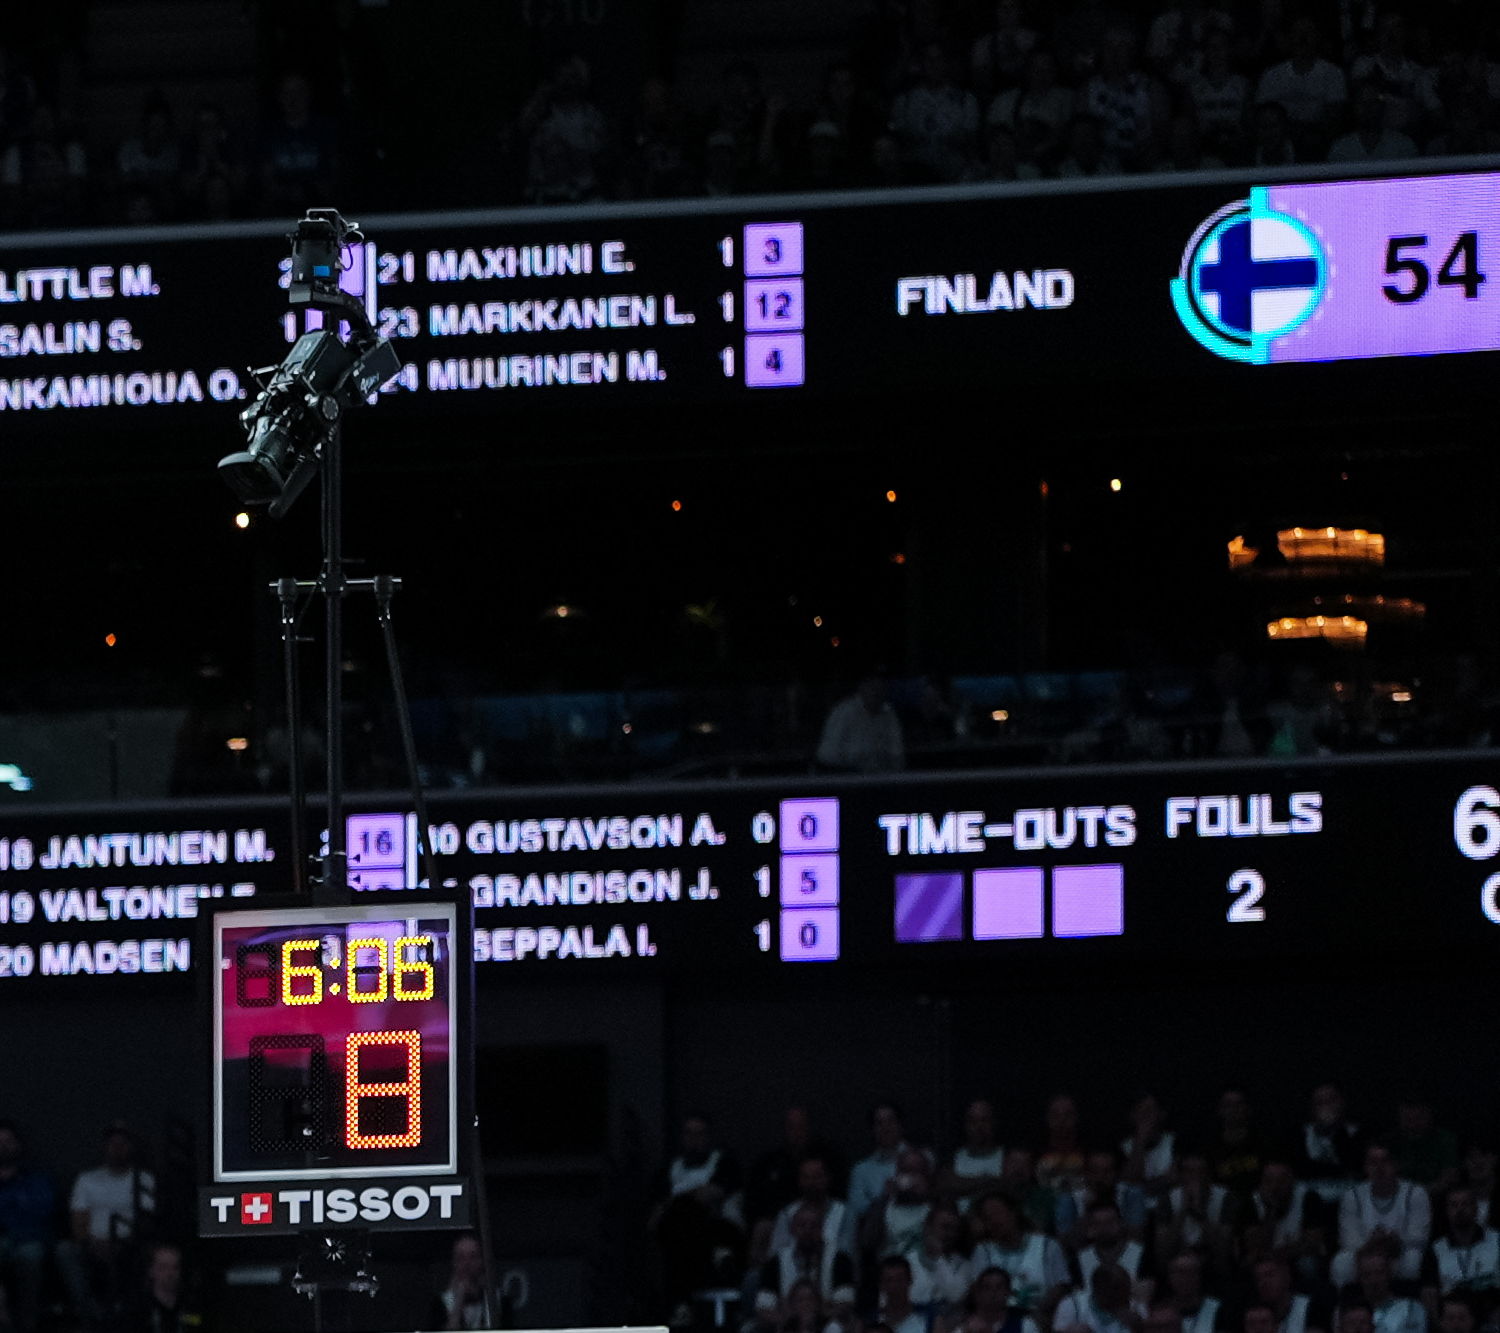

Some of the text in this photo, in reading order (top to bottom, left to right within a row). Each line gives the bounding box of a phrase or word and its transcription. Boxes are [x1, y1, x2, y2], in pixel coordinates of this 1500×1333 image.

[120, 263, 160, 296] M.
[377, 251, 415, 284] 21
[720, 236, 734, 267] 1
[764, 239, 781, 263] 3
[1381, 231, 1485, 305] 54
[897, 269, 1075, 315] FINLAND
[107, 317, 143, 352] S.
[377, 290, 792, 340] 23 MARKKANEN L. 1 12
[208, 367, 247, 401] O.
[426, 351, 619, 391] MUURINEN
[626, 349, 667, 381] M.
[720, 346, 734, 377] 1
[765, 348, 781, 373] 4
[466, 813, 683, 854] GUSTAVSON
[690, 812, 726, 846] A.
[752, 810, 776, 844] 0
[801, 813, 816, 839] 0
[879, 805, 1137, 855] TIME-OUTS
[1165, 792, 1323, 838] FOULS
[39, 830, 228, 868] JANTUNEN
[234, 828, 275, 862] M.
[360, 829, 393, 856] 16
[470, 864, 816, 908] GRANDISON J. 1 5
[1227, 867, 1266, 922] 2
[754, 918, 771, 951] 1
[801, 922, 816, 948] 0
[39, 938, 190, 976] MADSEN
[282, 936, 434, 1005] 6:06
[346, 1030, 421, 1150] 8
[211, 1184, 462, 1224] T TISSOT
